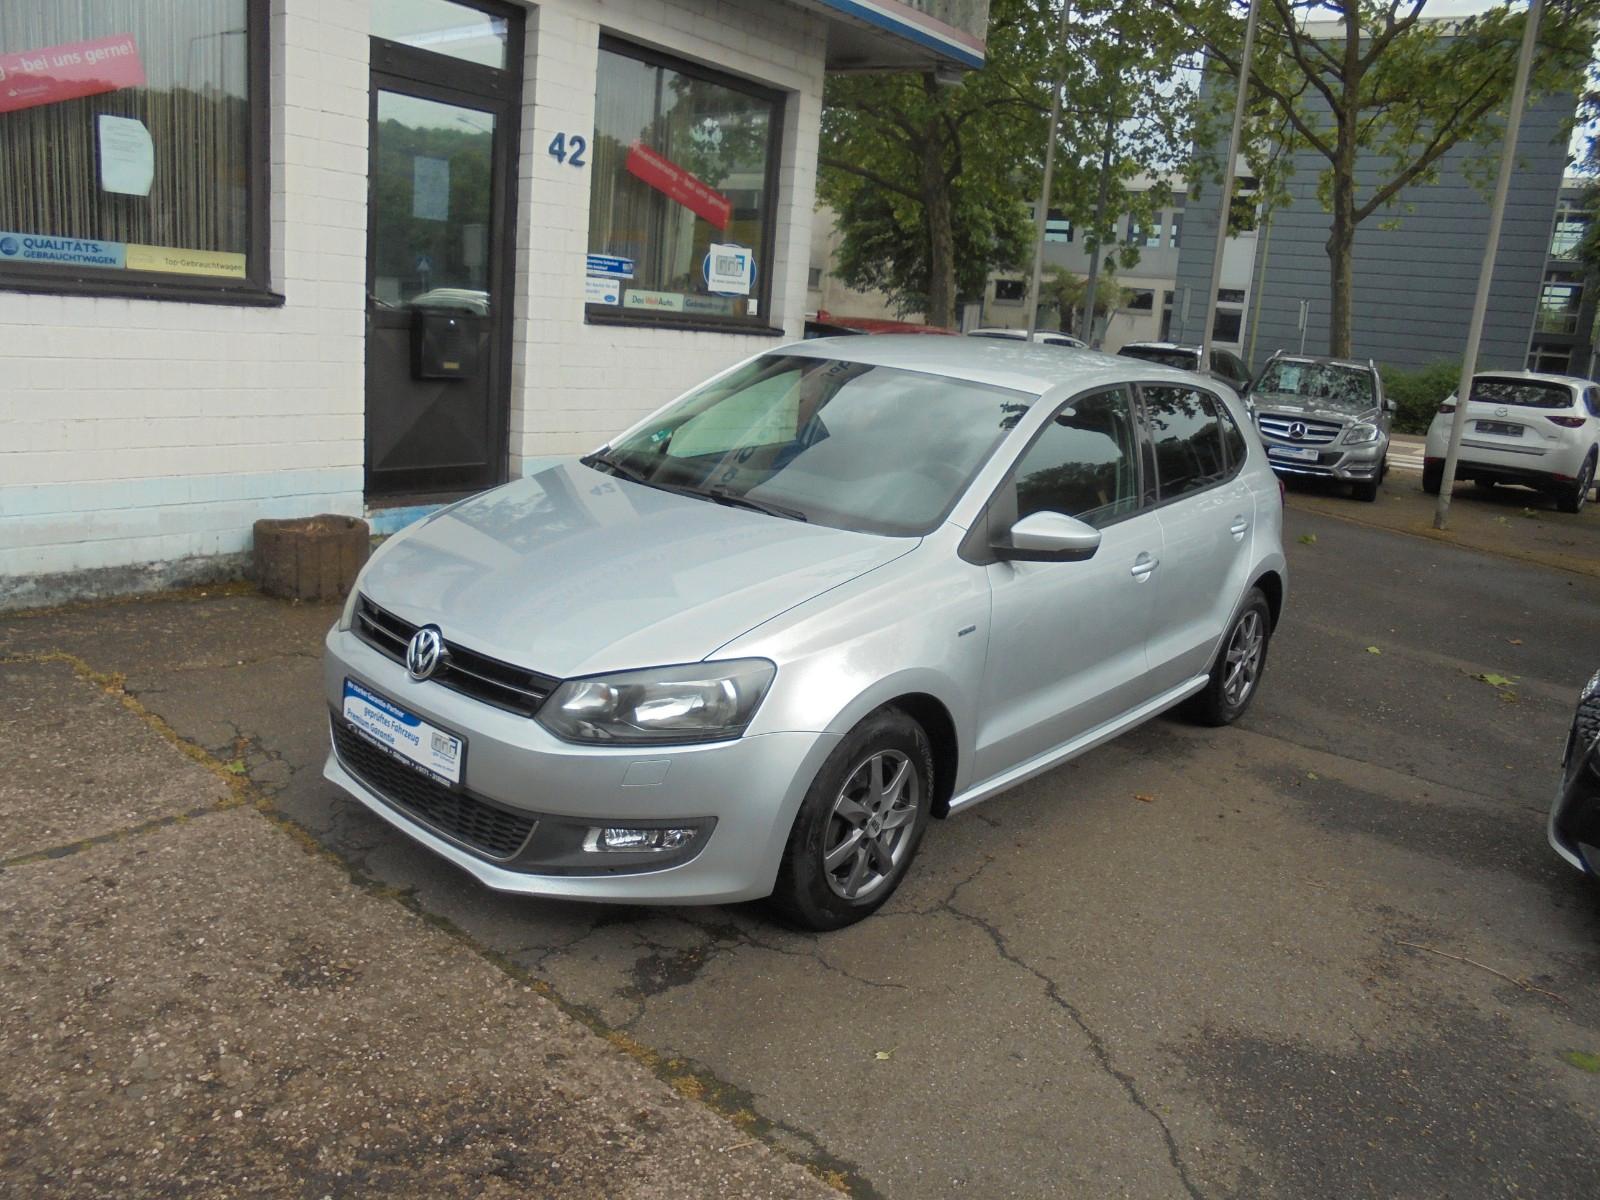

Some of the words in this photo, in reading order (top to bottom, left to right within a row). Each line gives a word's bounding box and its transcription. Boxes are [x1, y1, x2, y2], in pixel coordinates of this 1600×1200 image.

[21, 54, 49, 72] bei
[52, 51, 82, 67] uns
[548, 132, 587, 167] 42
[23, 250, 117, 265] GEBRAUCHTWAGEN
[347, 707, 370, 728] Premium
[370, 723, 396, 745] Garantie
[363, 706, 391, 728] geprüftes
[391, 721, 420, 746] Fahrzeug
